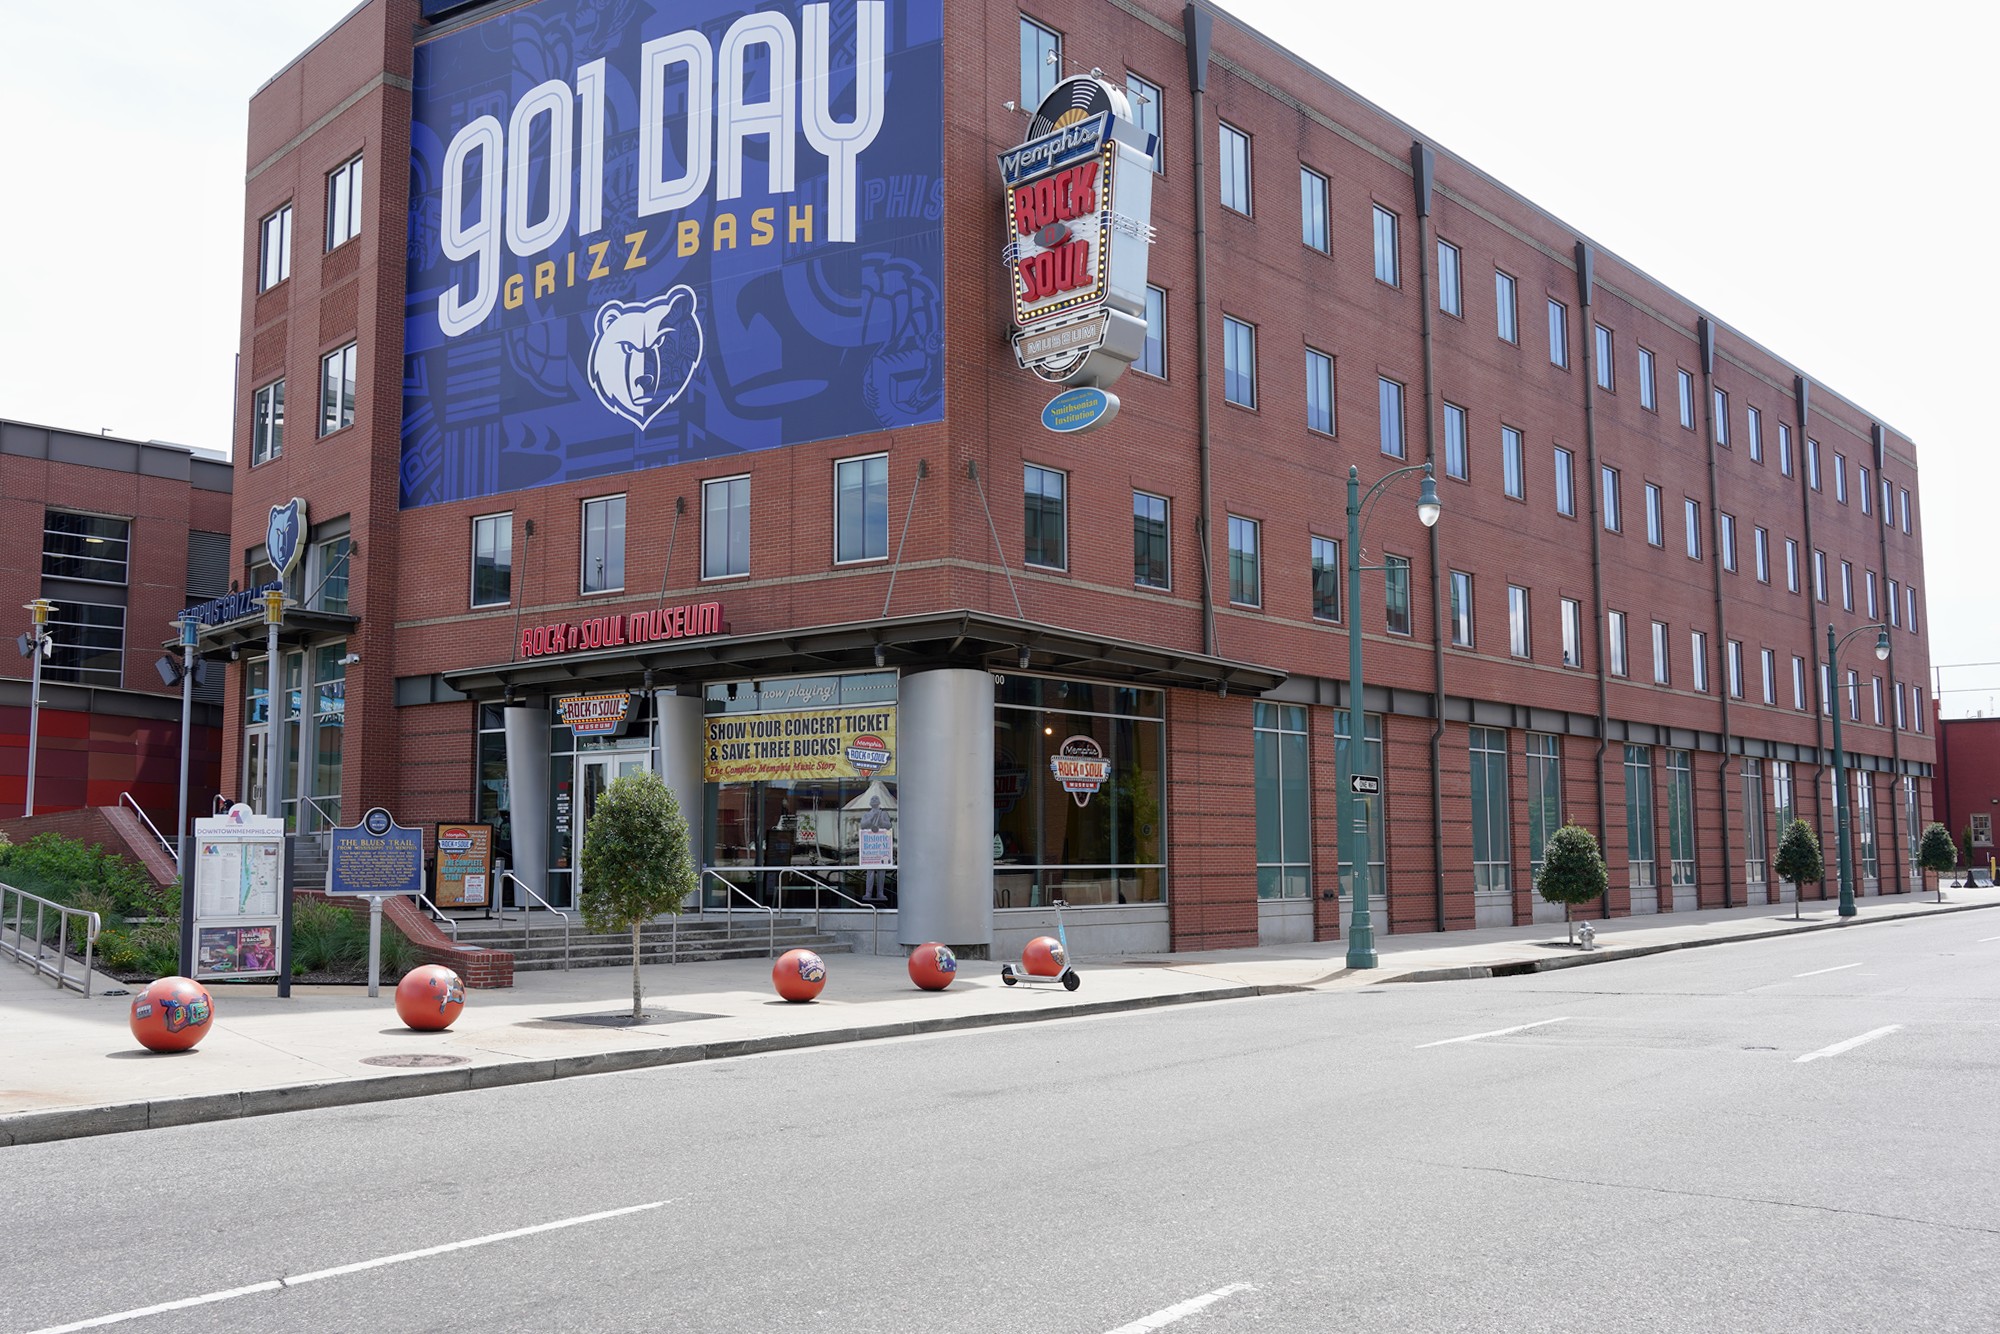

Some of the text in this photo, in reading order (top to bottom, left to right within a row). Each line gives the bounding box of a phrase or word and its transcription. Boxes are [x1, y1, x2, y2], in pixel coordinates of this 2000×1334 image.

[1002, 126, 1099, 179] Memphis
[438, 1, 884, 337] 901 DAY
[1014, 161, 1098, 236] ROCK
[504, 205, 813, 310] GRIZZ BASH
[1018, 239, 1093, 303] SOUL
[1027, 324, 1096, 354] MUSEUM
[1051, 399, 1098, 416] Smithsonian
[1055, 410, 1094, 425] Institution
[521, 623, 568, 657] ROCK
[580, 615, 625, 649] SOUL
[629, 602, 719, 643] MUSEUM
[761, 682, 838, 704] now playing!
[567, 702, 591, 719] ROCK
[598, 700, 621, 716] SOUL
[710, 713, 890, 740] SHOW YOUR CONCERT TICKET
[710, 738, 841, 761] & SAVE THREE BUCKS!
[851, 750, 866, 760] ROCK
[871, 753, 885, 762] SOUL
[710, 761, 837, 776] The Complete Memphis Music Story
[1058, 761, 1079, 776] ROCK
[1085, 763, 1103, 777] SOUL
